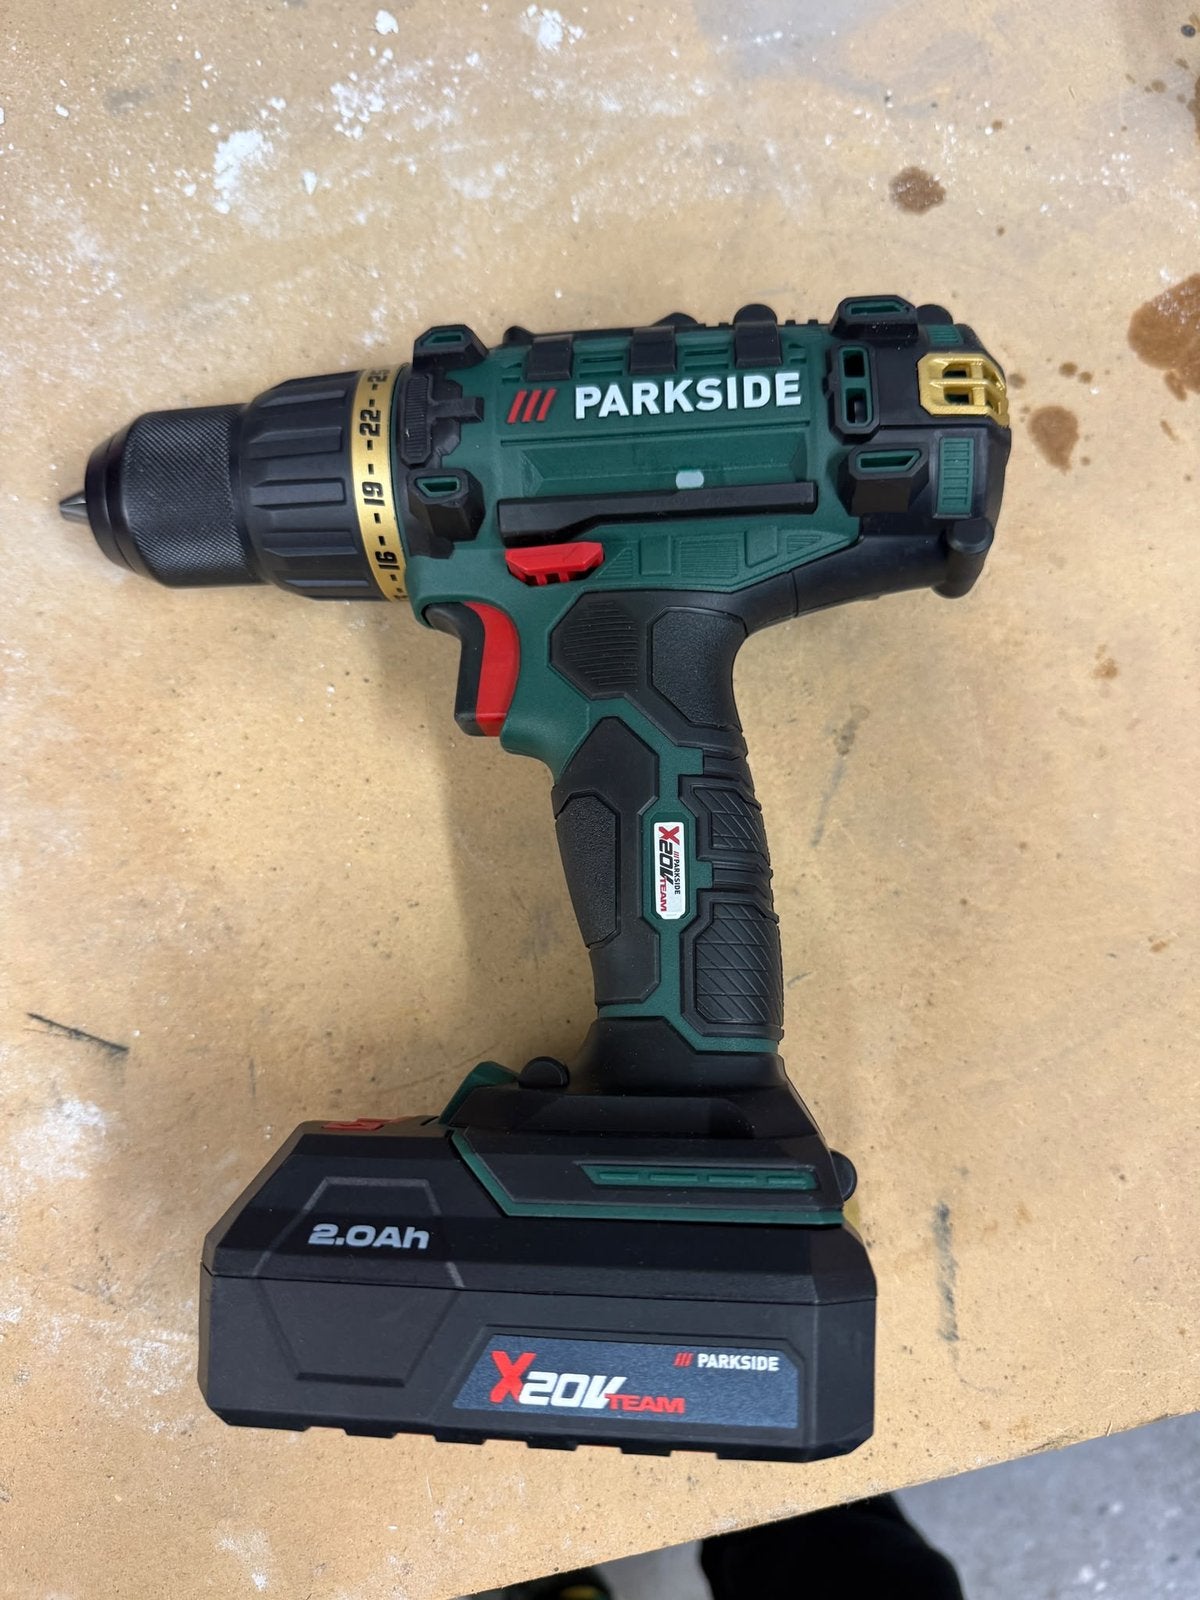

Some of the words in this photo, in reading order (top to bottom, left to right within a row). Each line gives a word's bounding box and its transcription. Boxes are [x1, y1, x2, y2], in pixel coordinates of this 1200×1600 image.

[575, 372, 801, 420] PARKSIDE
[359, 409, 382, 437] 22
[362, 481, 385, 507] 19
[375, 550, 400, 571] 16
[673, 859, 681, 895] PARKSIDE
[660, 878, 668, 912] TEAM
[308, 1223, 430, 1250] 2.0Ah
[697, 1353, 780, 1372] PARKSIDE
[606, 1393, 686, 1414] TEAM
